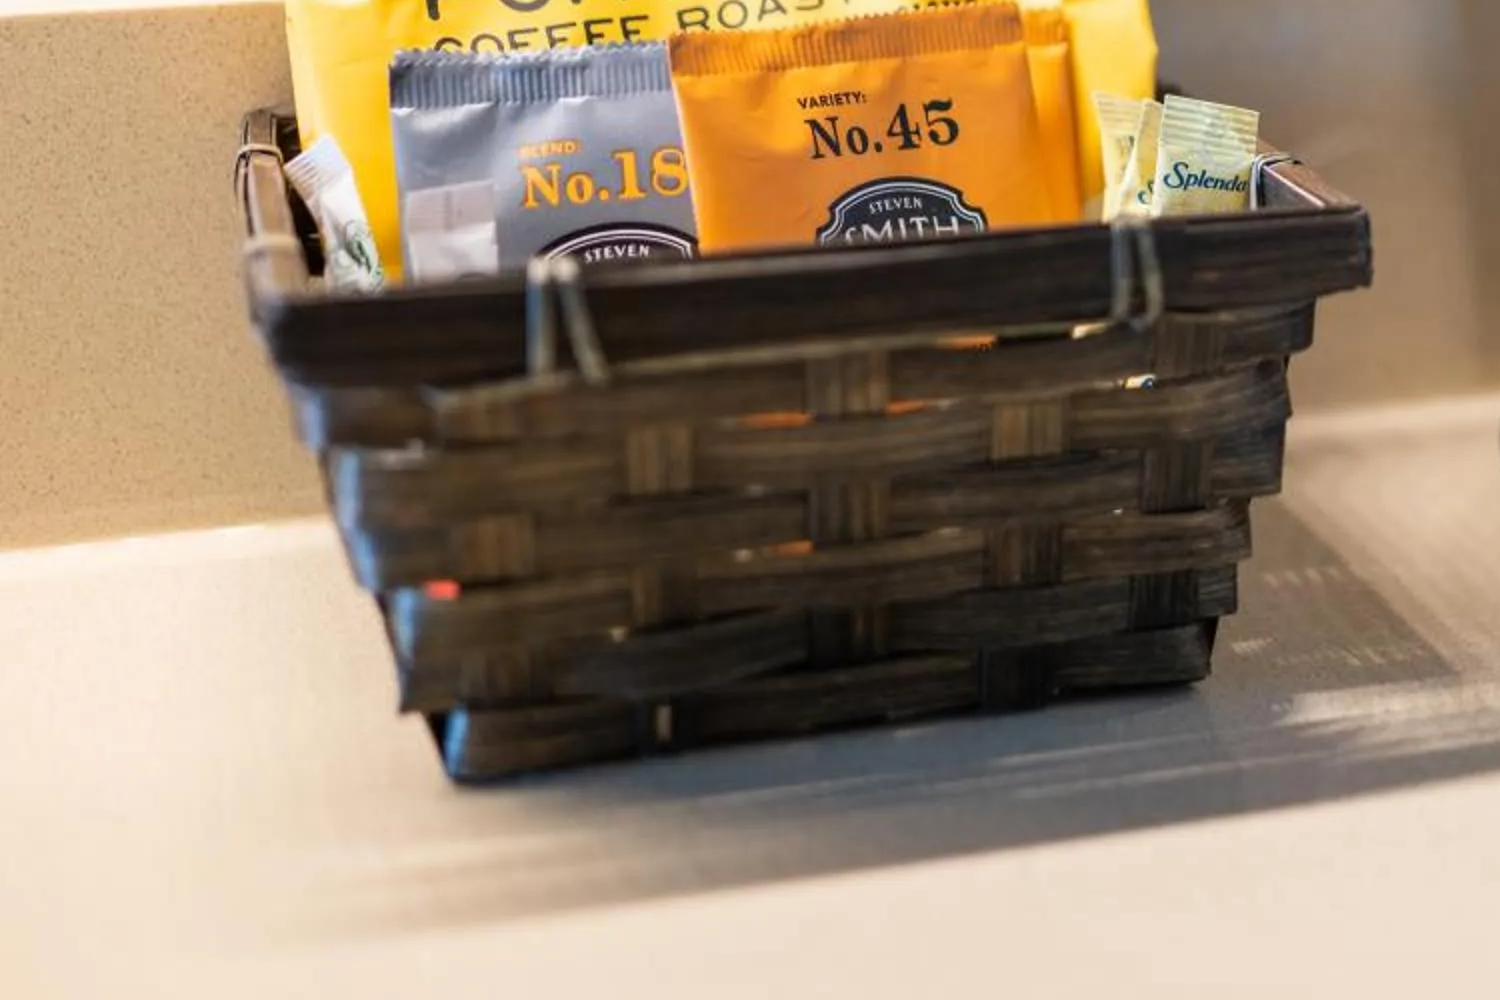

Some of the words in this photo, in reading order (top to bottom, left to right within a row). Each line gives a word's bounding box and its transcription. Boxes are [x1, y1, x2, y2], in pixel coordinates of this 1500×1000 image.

[1163, 161, 1250, 193] Splenda
[868, 196, 924, 215] STEVEN
[583, 243, 651, 264] STEVEN
